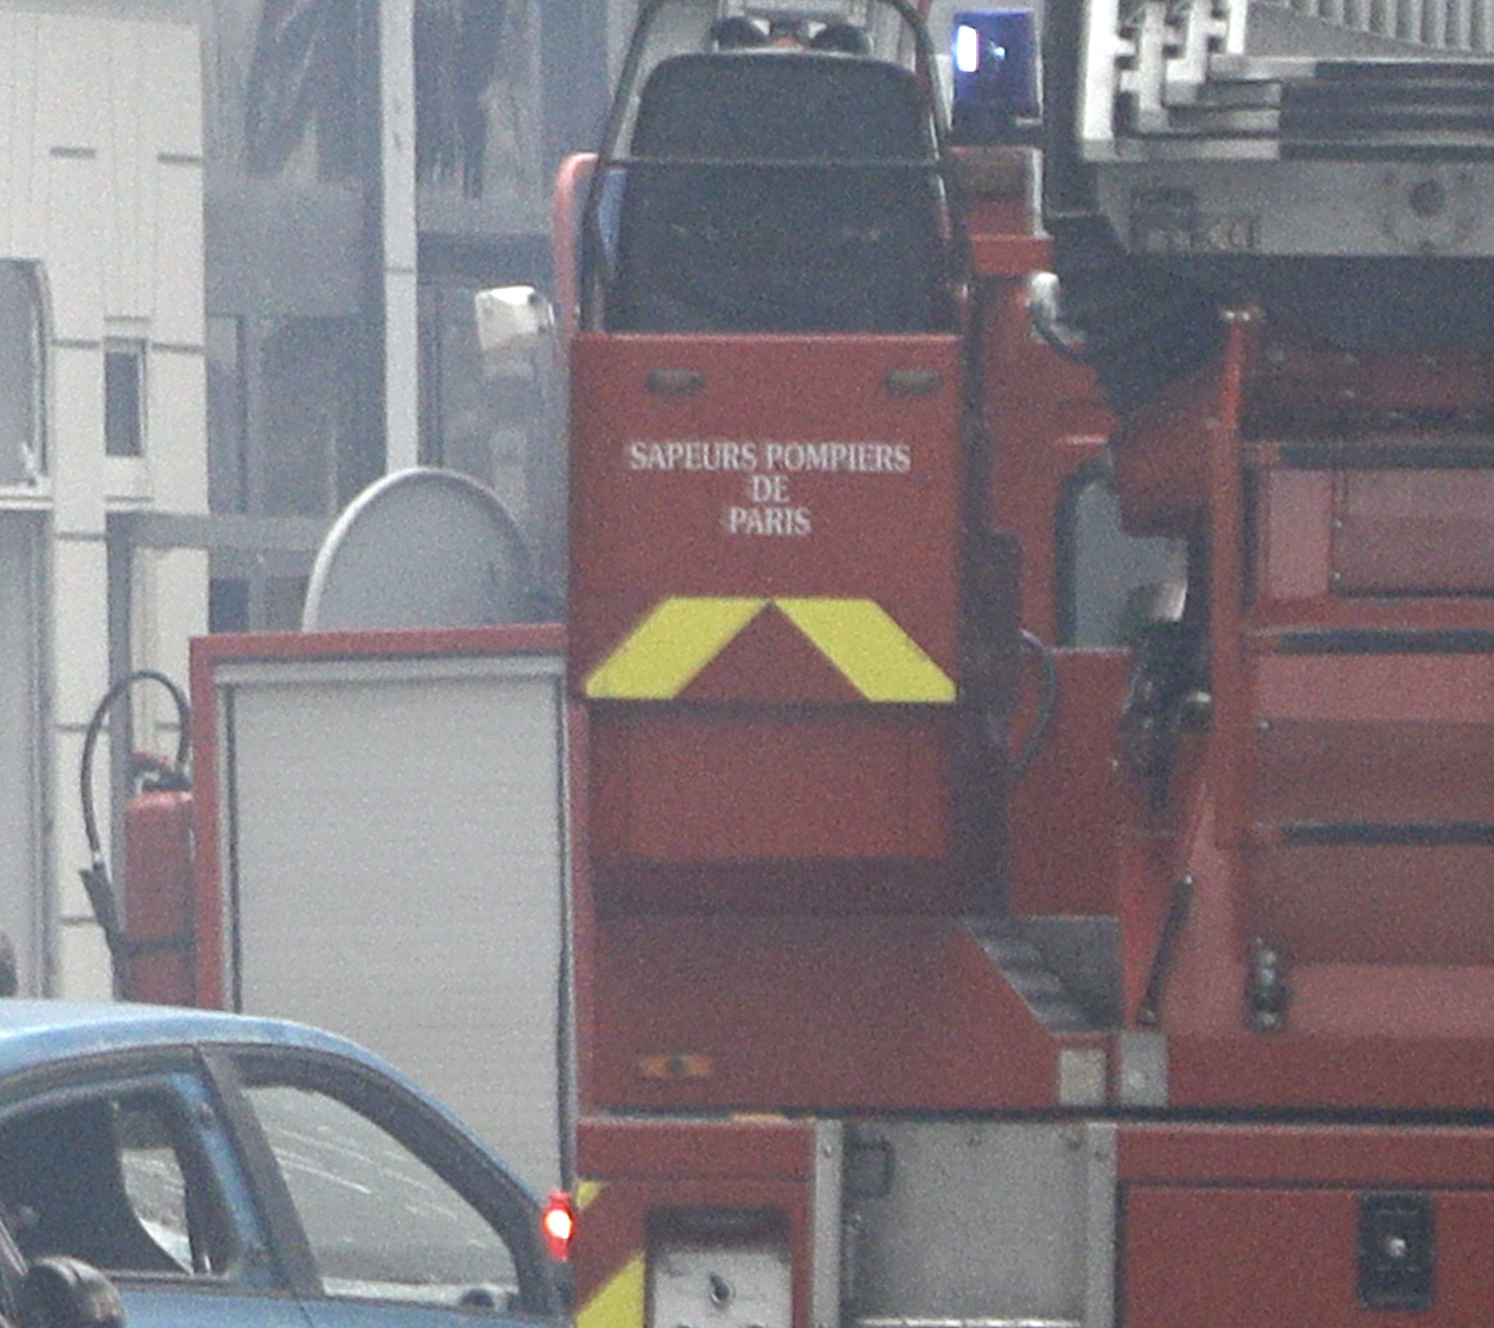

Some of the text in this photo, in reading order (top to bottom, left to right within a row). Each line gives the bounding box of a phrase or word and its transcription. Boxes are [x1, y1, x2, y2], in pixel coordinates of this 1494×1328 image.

[629, 441, 912, 472] SAPEURS POMPIERS
[751, 474, 791, 503] DE
[726, 505, 814, 536] PARIS
